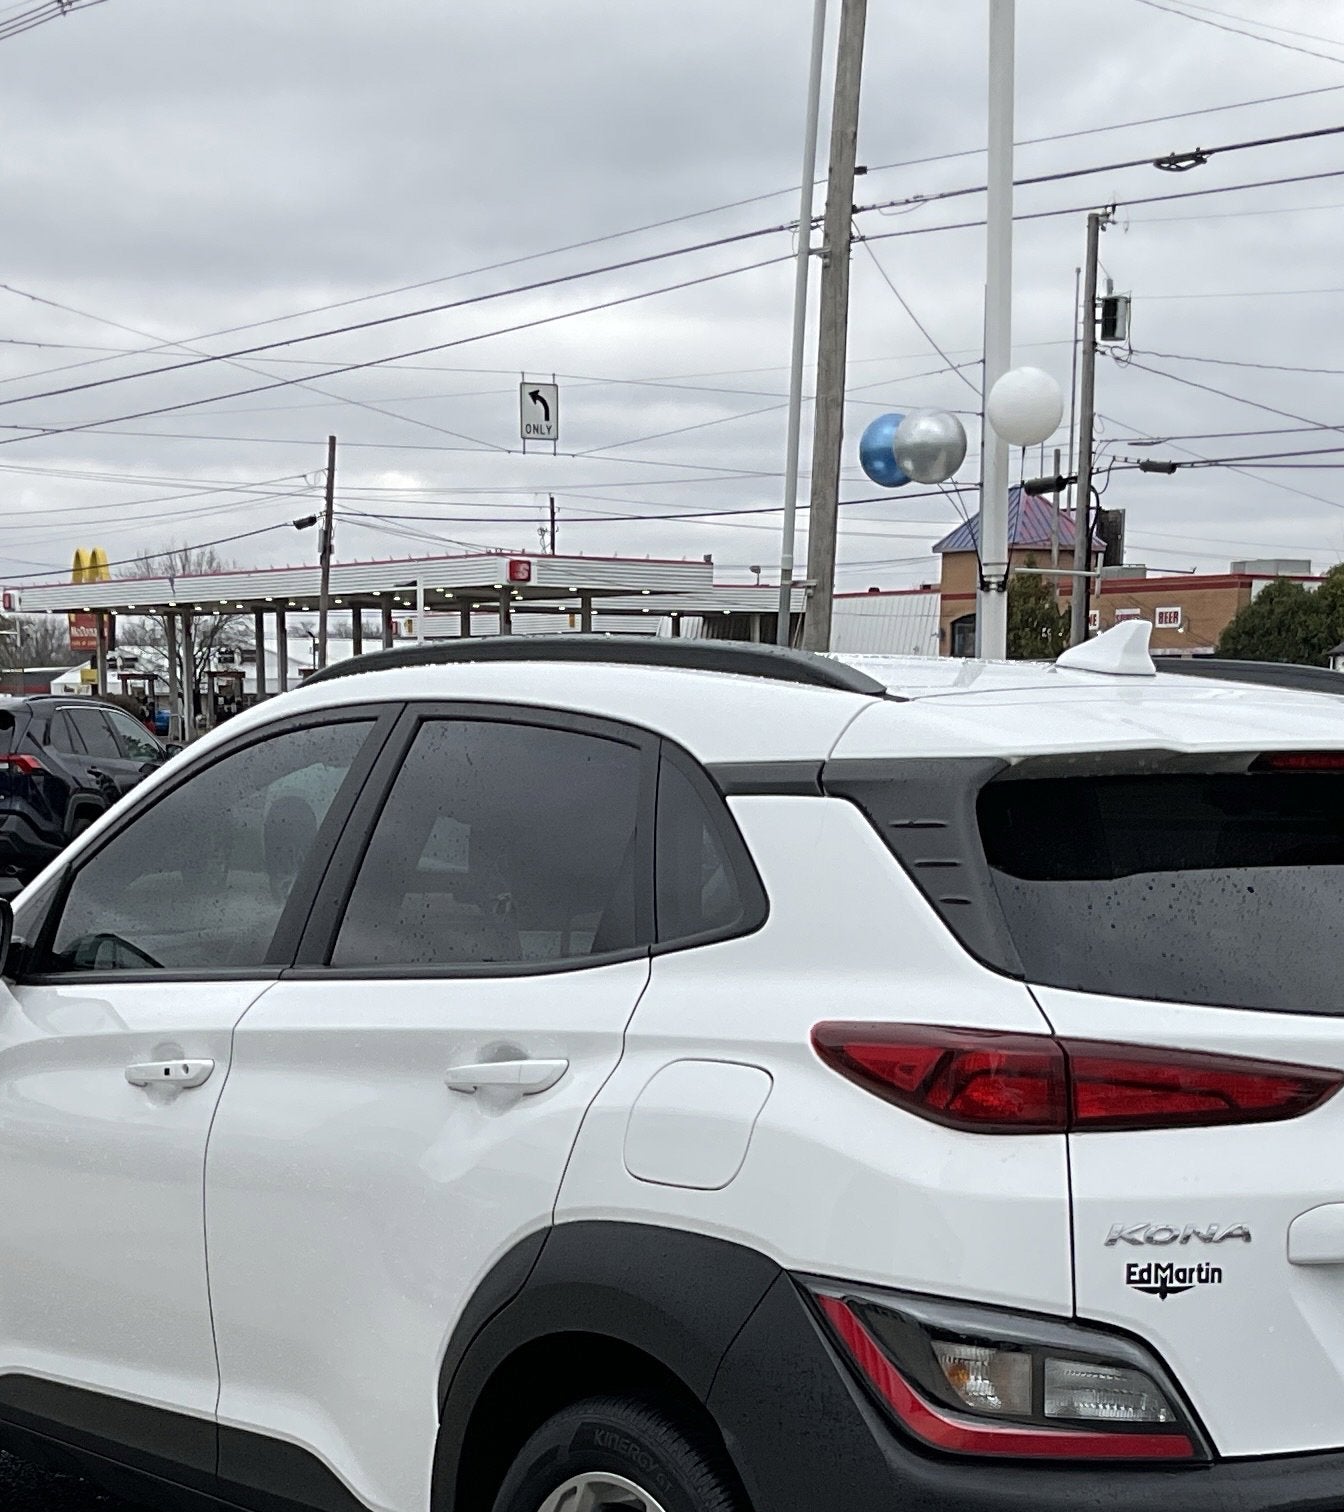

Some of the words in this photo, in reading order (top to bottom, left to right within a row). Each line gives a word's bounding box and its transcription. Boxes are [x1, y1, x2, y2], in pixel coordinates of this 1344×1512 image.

[525, 423, 553, 435] ONLY
[1158, 611, 1179, 624] BEER
[1104, 1222, 1252, 1246] KONA
